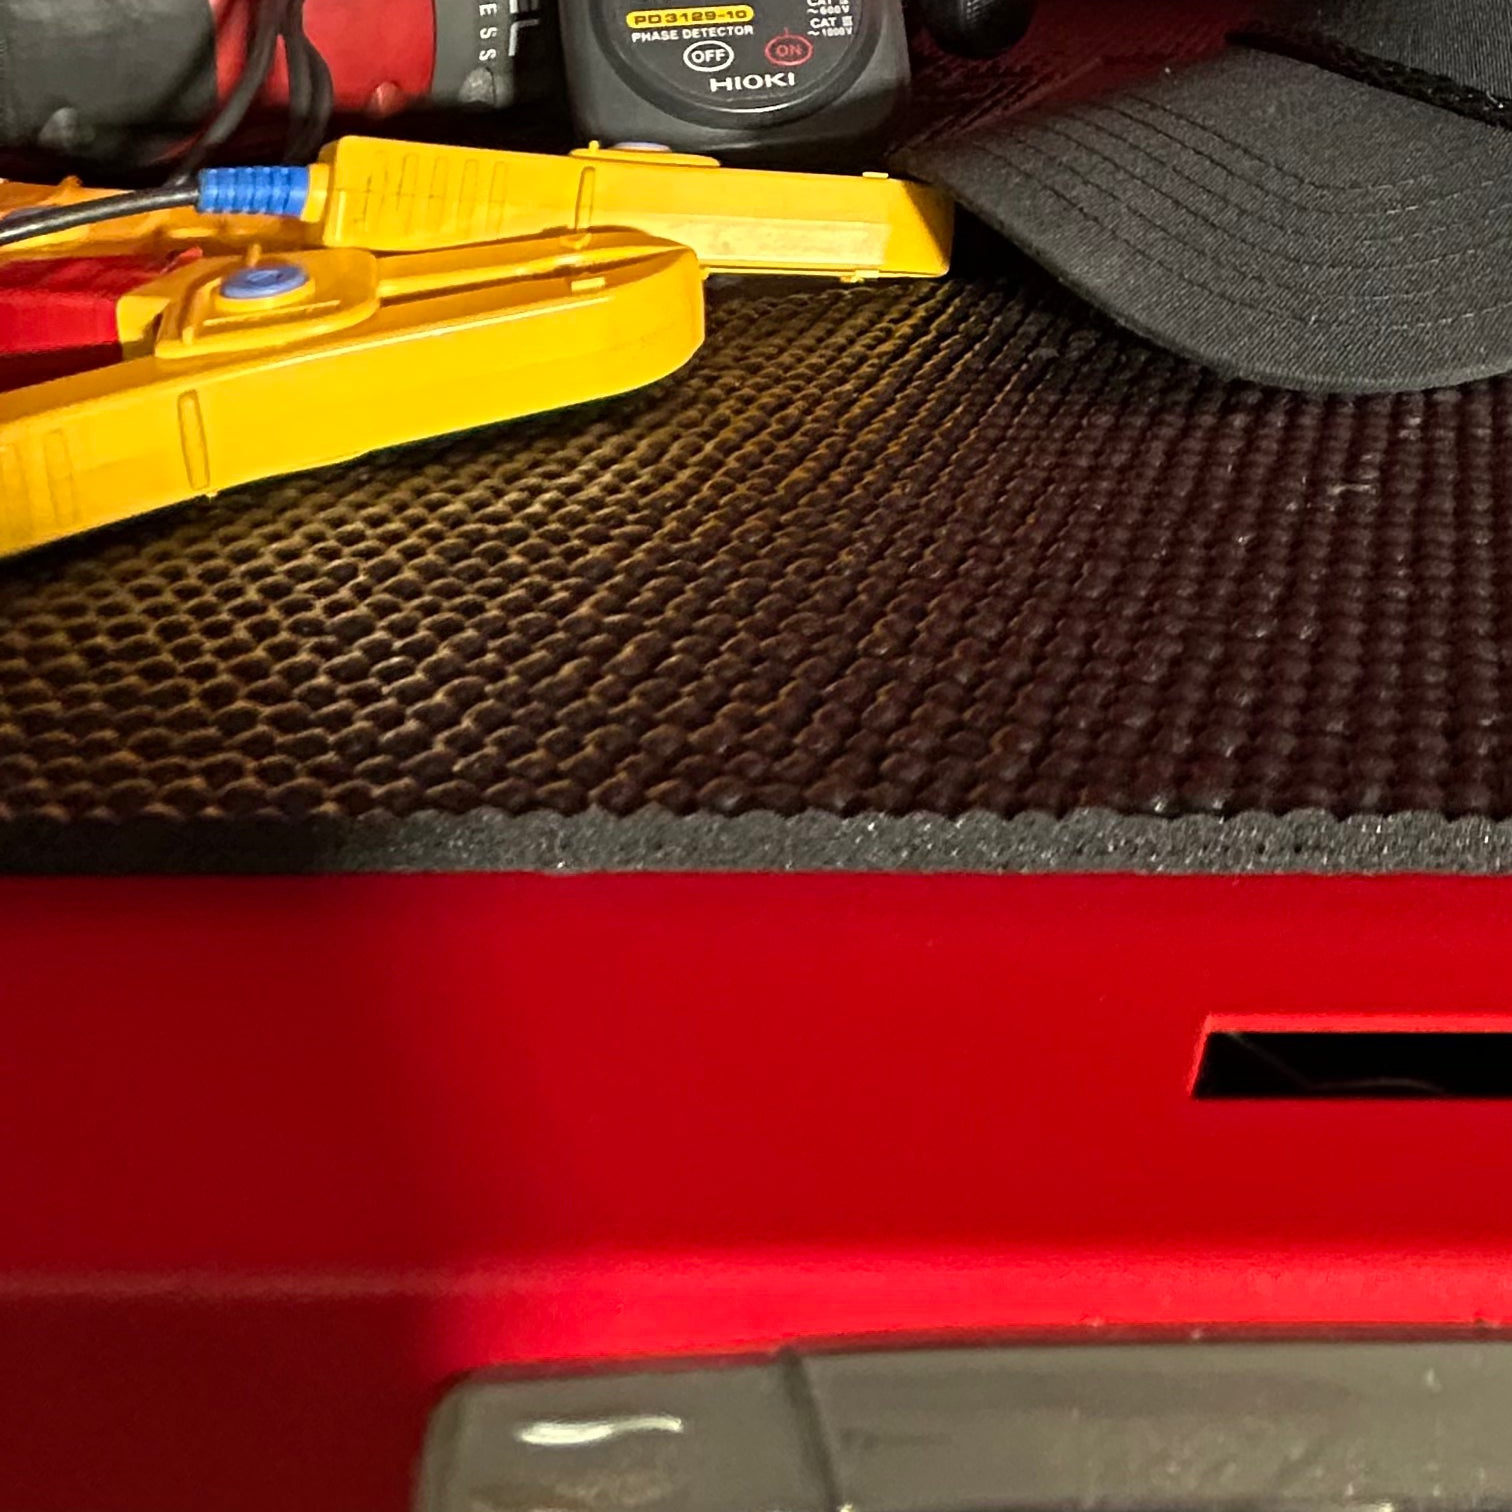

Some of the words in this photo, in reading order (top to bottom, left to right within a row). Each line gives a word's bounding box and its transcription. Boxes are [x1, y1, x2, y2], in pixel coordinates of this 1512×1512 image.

[809, 16, 838, 29] CAT
[631, 29, 680, 43] PHASE
[681, 25, 754, 39] DETECTOR
[691, 48, 726, 64] OFF
[775, 44, 803, 58] ON
[709, 71, 796, 93] HIOKI
